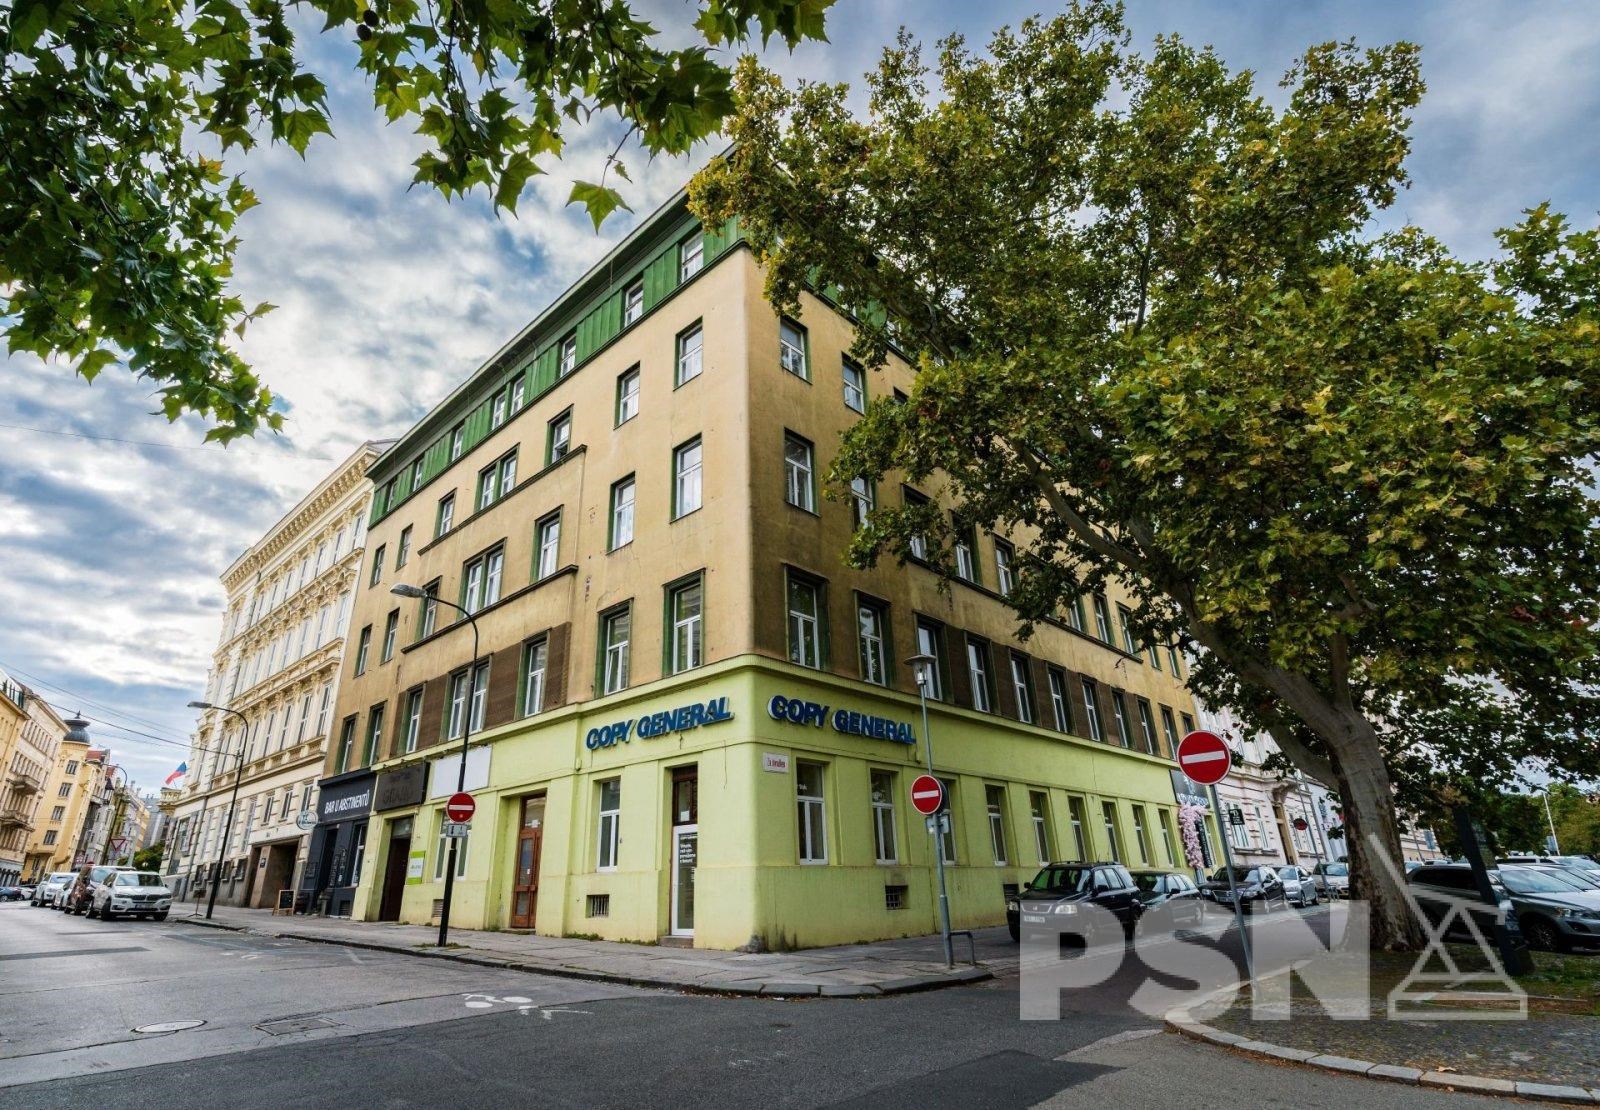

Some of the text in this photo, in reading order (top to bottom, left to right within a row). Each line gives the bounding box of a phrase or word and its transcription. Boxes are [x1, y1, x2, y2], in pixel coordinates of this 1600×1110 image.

[586, 696, 734, 750] COPY GENERAL
[768, 695, 917, 745] COPY GENERAL
[324, 800, 335, 814] BAR
